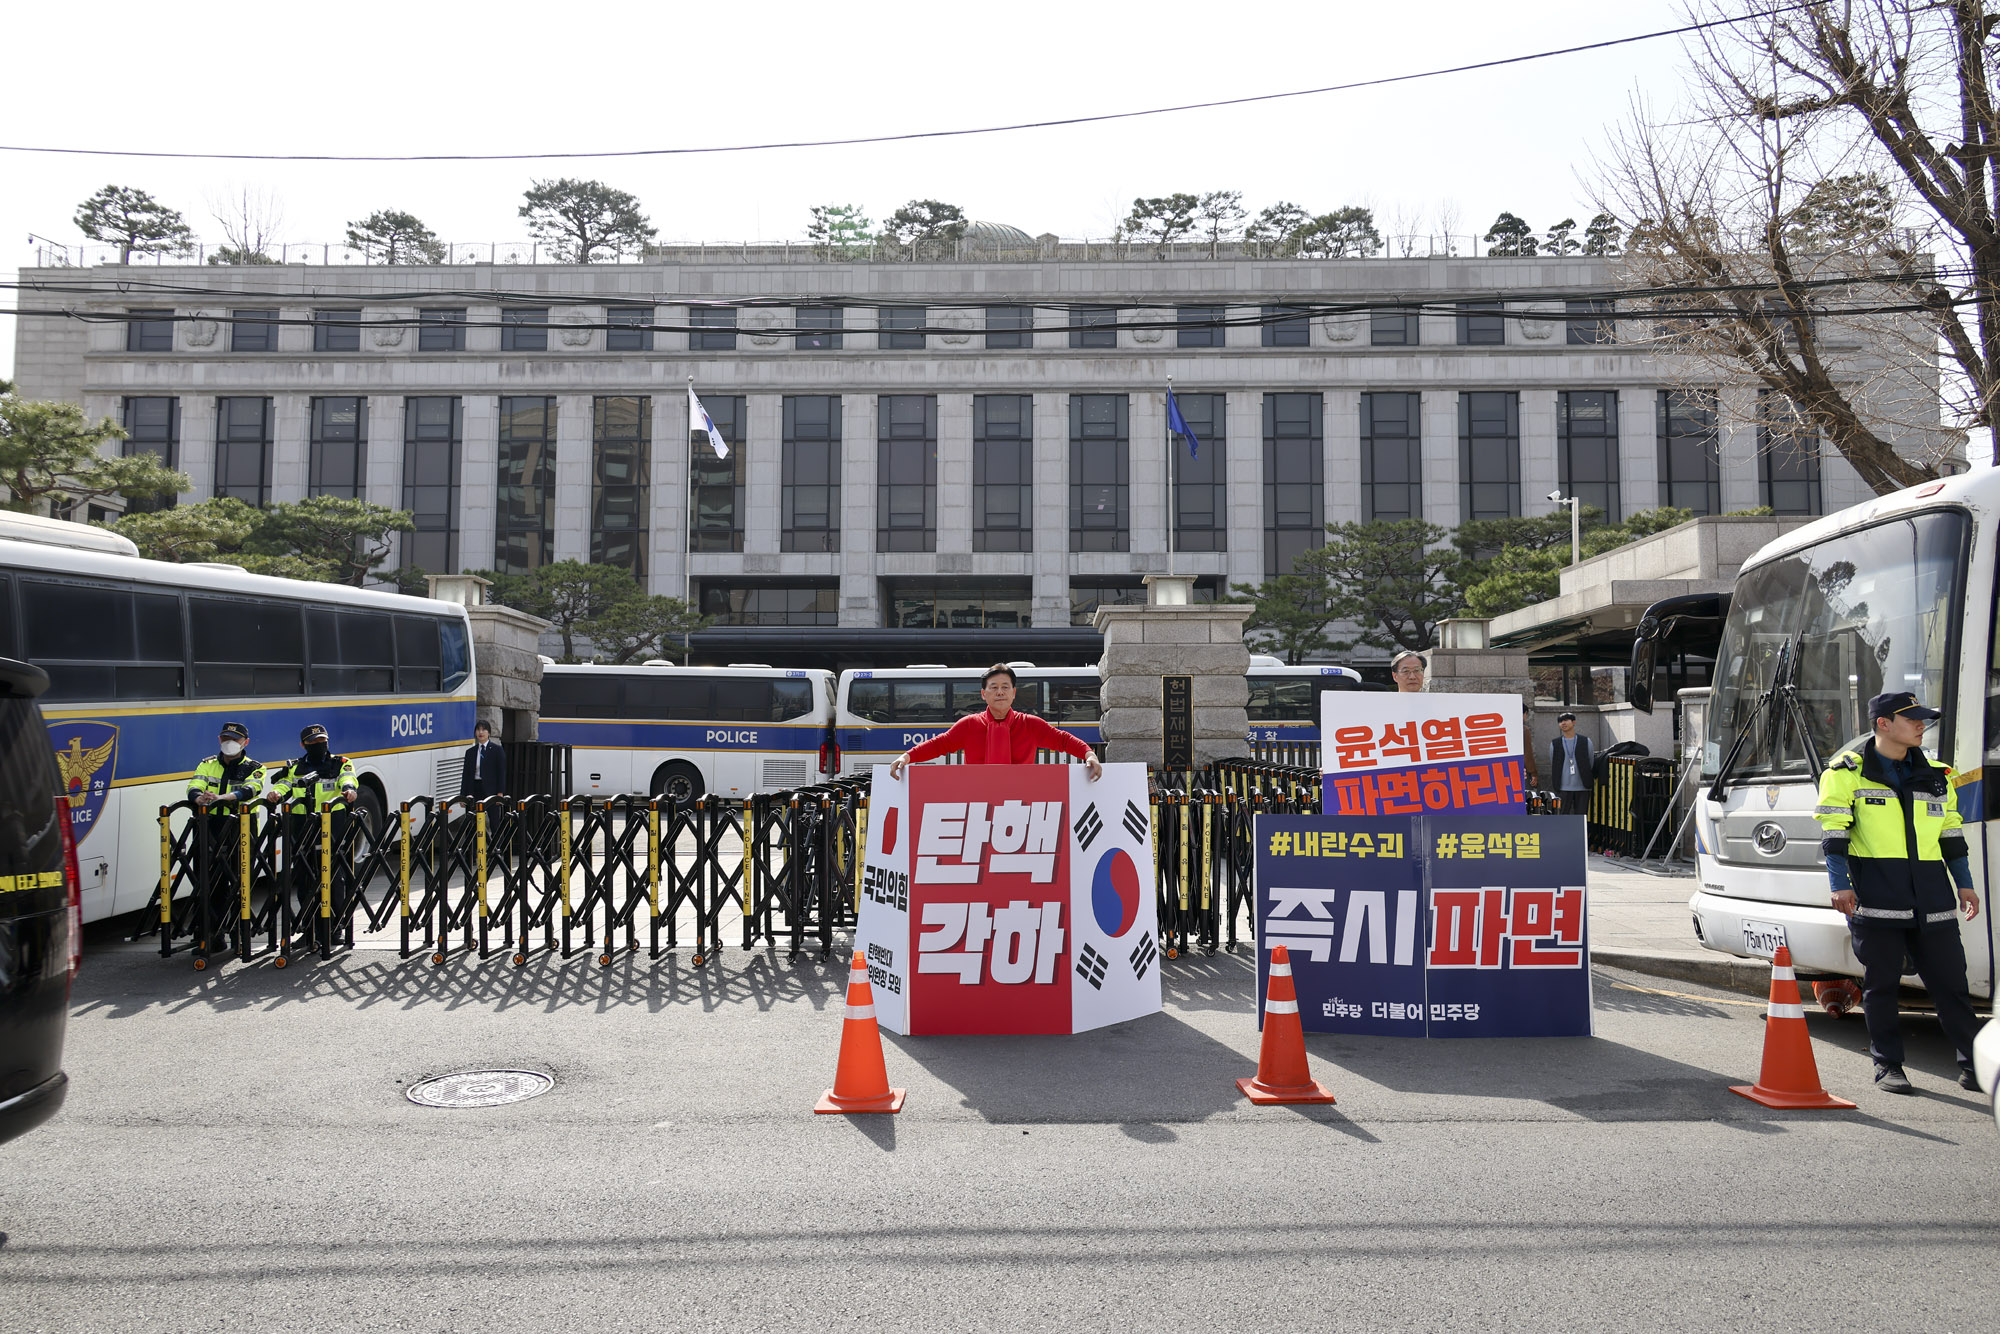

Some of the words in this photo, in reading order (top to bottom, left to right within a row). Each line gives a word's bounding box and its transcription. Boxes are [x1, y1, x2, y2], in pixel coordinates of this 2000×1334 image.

[392, 713, 433, 737] POLICE
[707, 731, 757, 744] POLICE
[1170, 680, 1185, 767] 헌법재판소
[904, 733, 937, 746] POL
[1335, 712, 1508, 769] 윤석열을
[94, 780, 104, 796] 찰
[1334, 761, 1523, 815] 파면하라!
[71, 809, 92, 823] LICE
[914, 800, 1063, 884] 탄핵
[1270, 831, 1403, 859] #내란수괴
[1436, 833, 1540, 859] #윤석열
[864, 865, 909, 912] 국민의힘
[1265, 887, 1417, 966] 즉시
[1427, 886, 1585, 969] 파면
[868, 943, 893, 968] 탄핵반대
[918, 901, 1064, 985] 각하
[867, 964, 887, 988] 위원장
[888, 973, 901, 995] 모임
[1322, 1003, 1363, 1018] 민주당
[1371, 1002, 1423, 1021] 더불어
[1430, 1003, 1480, 1021] 민주당
